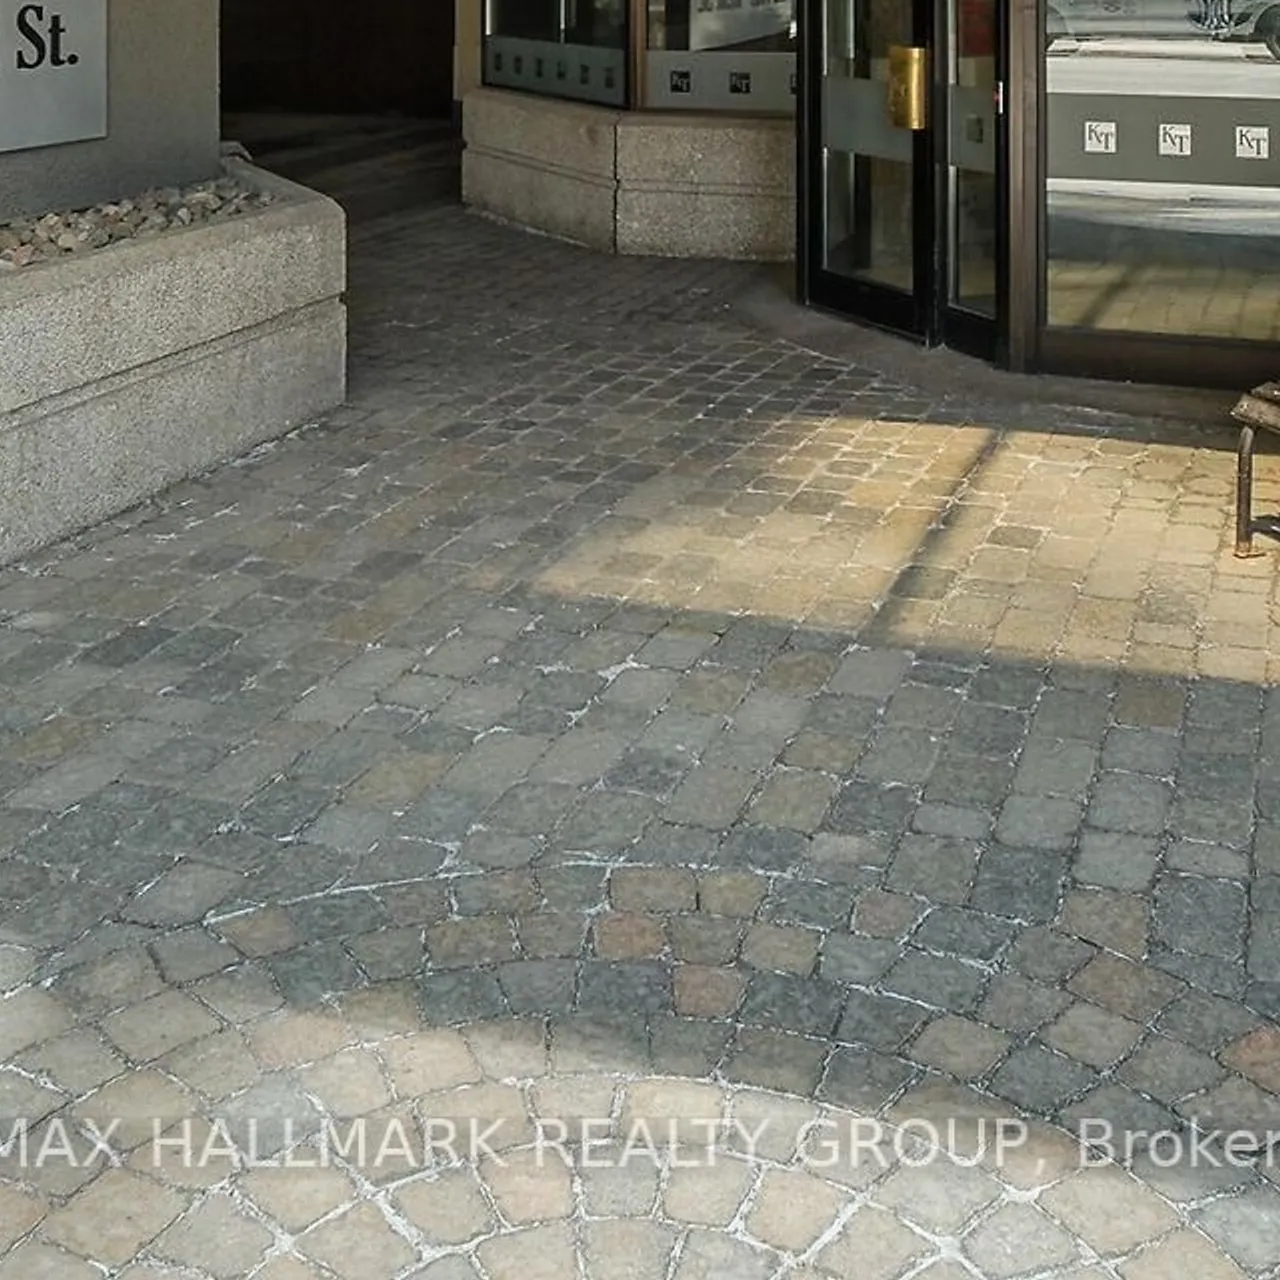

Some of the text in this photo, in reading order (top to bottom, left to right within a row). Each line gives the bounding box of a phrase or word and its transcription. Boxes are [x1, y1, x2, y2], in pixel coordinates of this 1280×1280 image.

[16, 3, 80, 71] St.
[1088, 124, 1114, 151] KT
[1162, 126, 1189, 153] KT
[1239, 129, 1267, 156] KT
